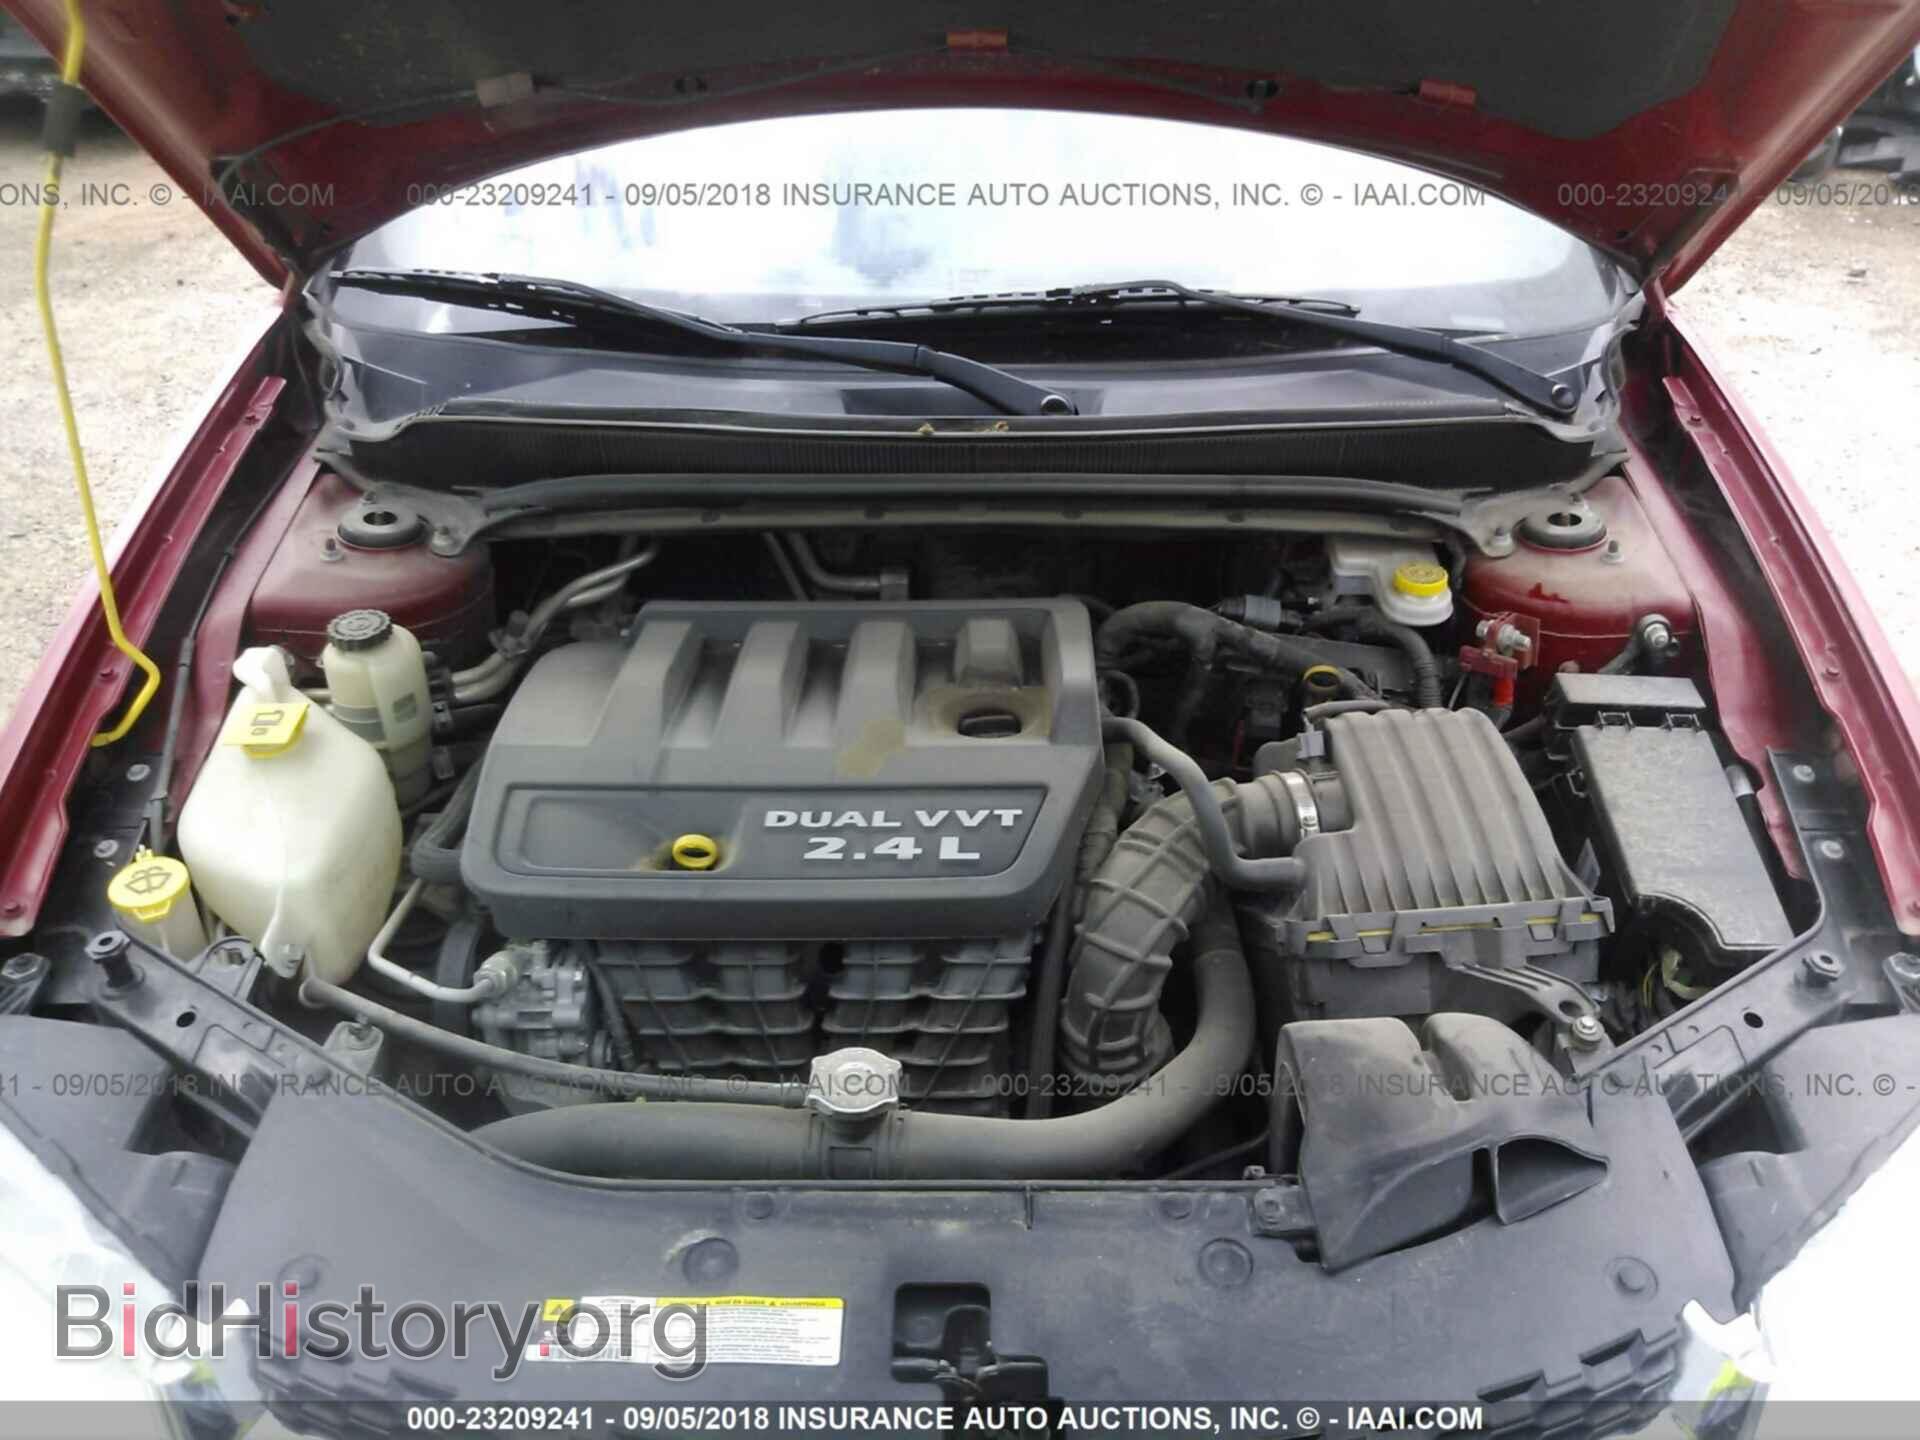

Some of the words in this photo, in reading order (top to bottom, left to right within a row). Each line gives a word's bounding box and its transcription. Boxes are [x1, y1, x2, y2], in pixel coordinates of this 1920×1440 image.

[764, 811, 901, 827] DUAL
[915, 809, 1023, 827] VVT
[803, 837, 923, 860] 2.4
[939, 837, 981, 860] L
